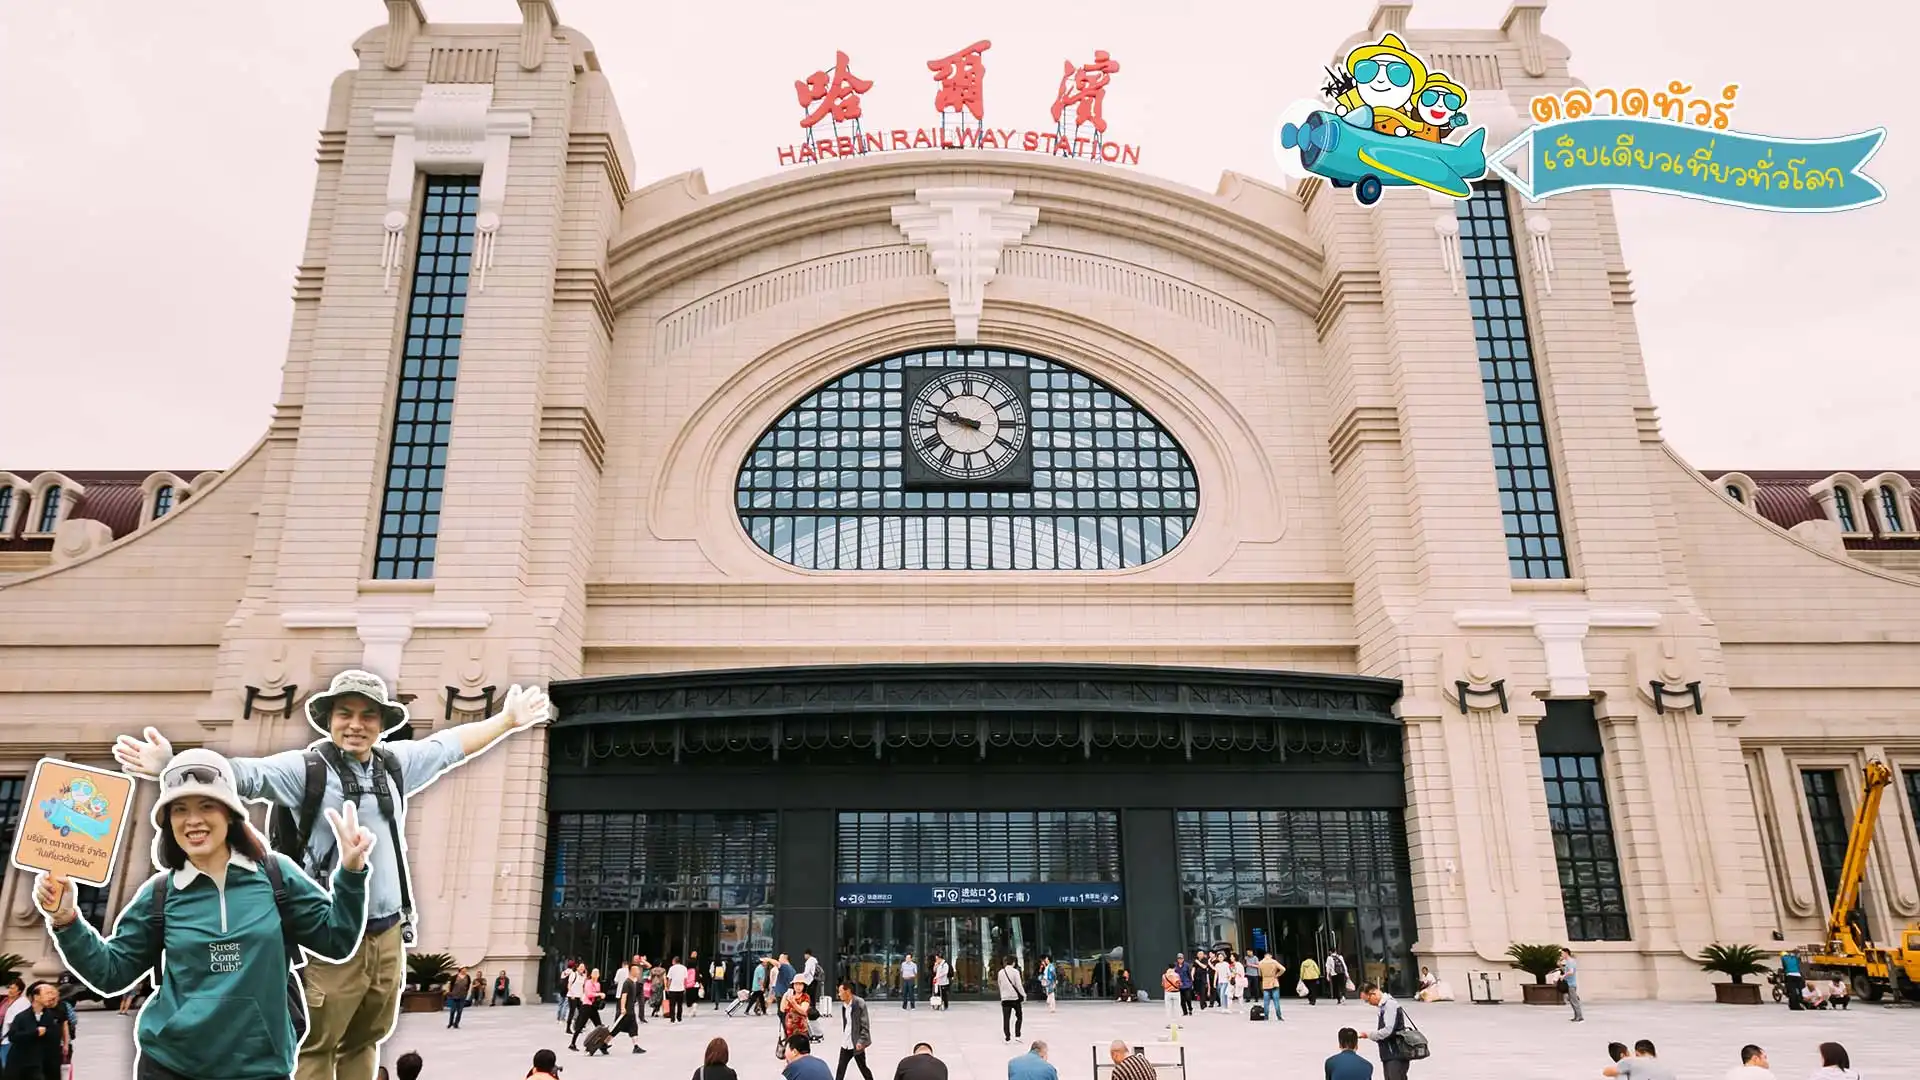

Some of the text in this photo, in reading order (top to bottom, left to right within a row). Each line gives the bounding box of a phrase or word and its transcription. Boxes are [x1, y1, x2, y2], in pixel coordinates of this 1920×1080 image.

[777, 127, 1141, 166] HARBIN RAILWAY STATION
[961, 888, 986, 898] 进站口
[987, 888, 997, 903] 3
[209, 942, 241, 952] Street
[210, 952, 240, 962] Komé
